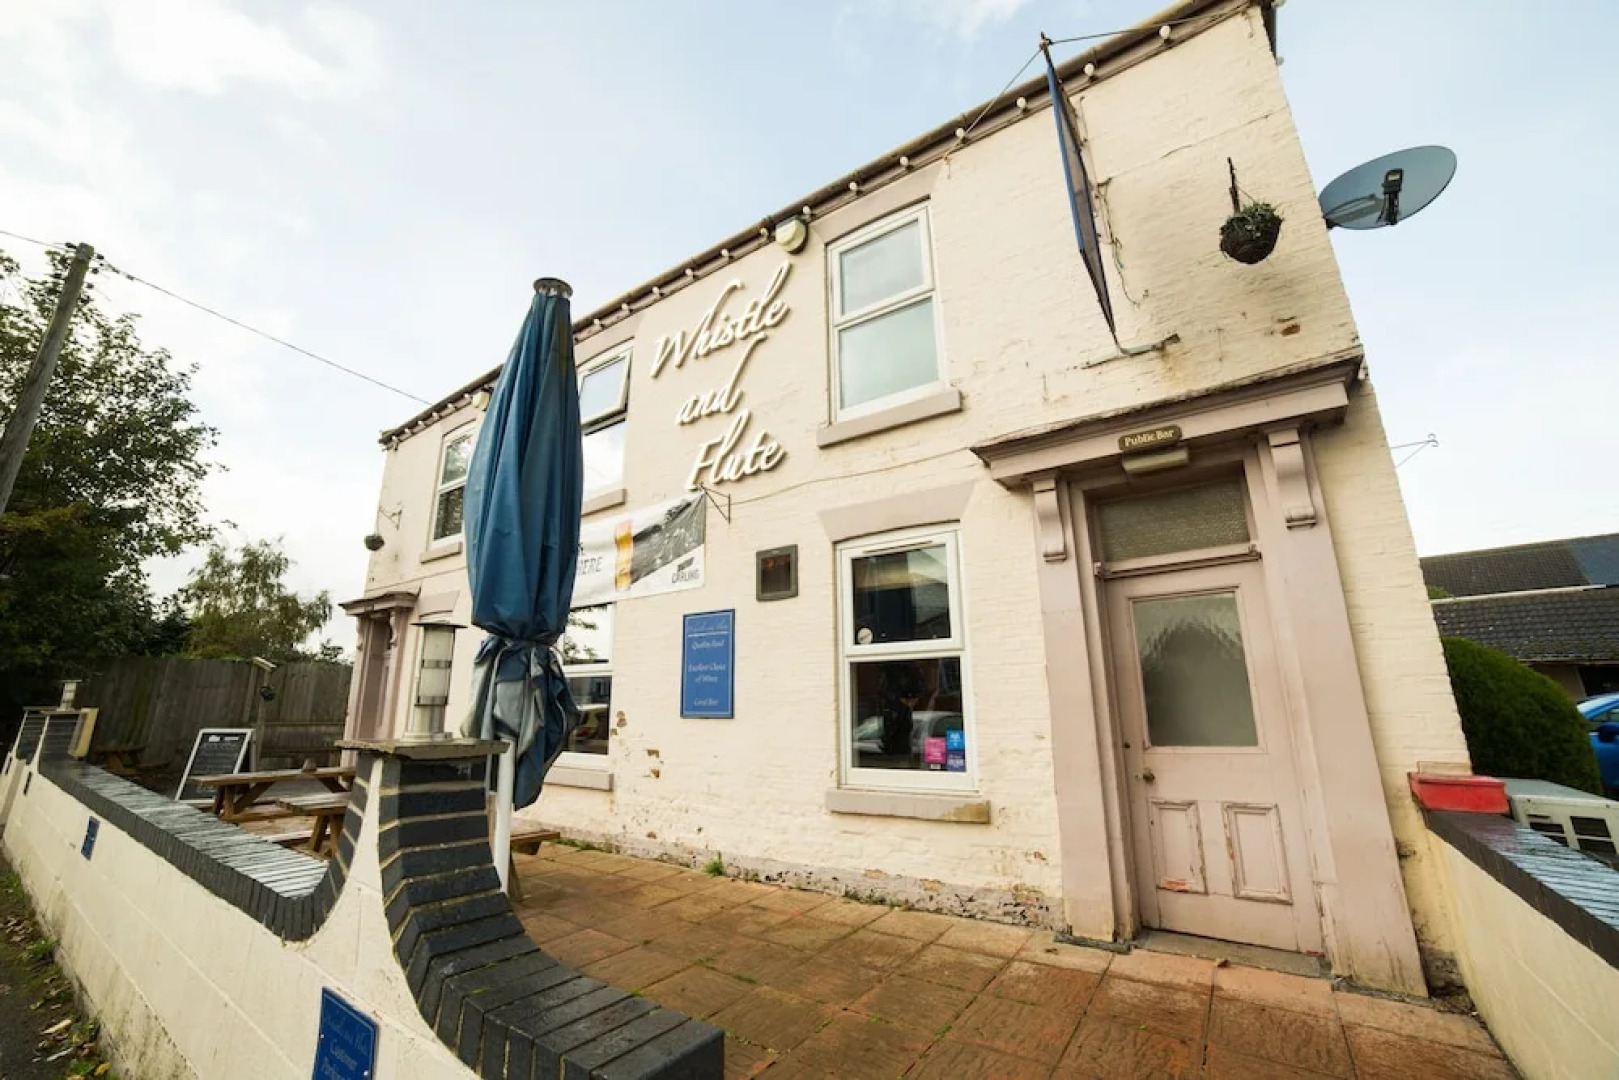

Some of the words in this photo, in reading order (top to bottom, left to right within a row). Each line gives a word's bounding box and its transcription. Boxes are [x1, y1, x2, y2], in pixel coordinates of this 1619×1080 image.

[650, 259, 792, 379] Whistle
[676, 331, 767, 426] and
[684, 407, 787, 491] Flute
[1124, 434, 1156, 447] Public
[1156, 430, 1174, 440] Bar
